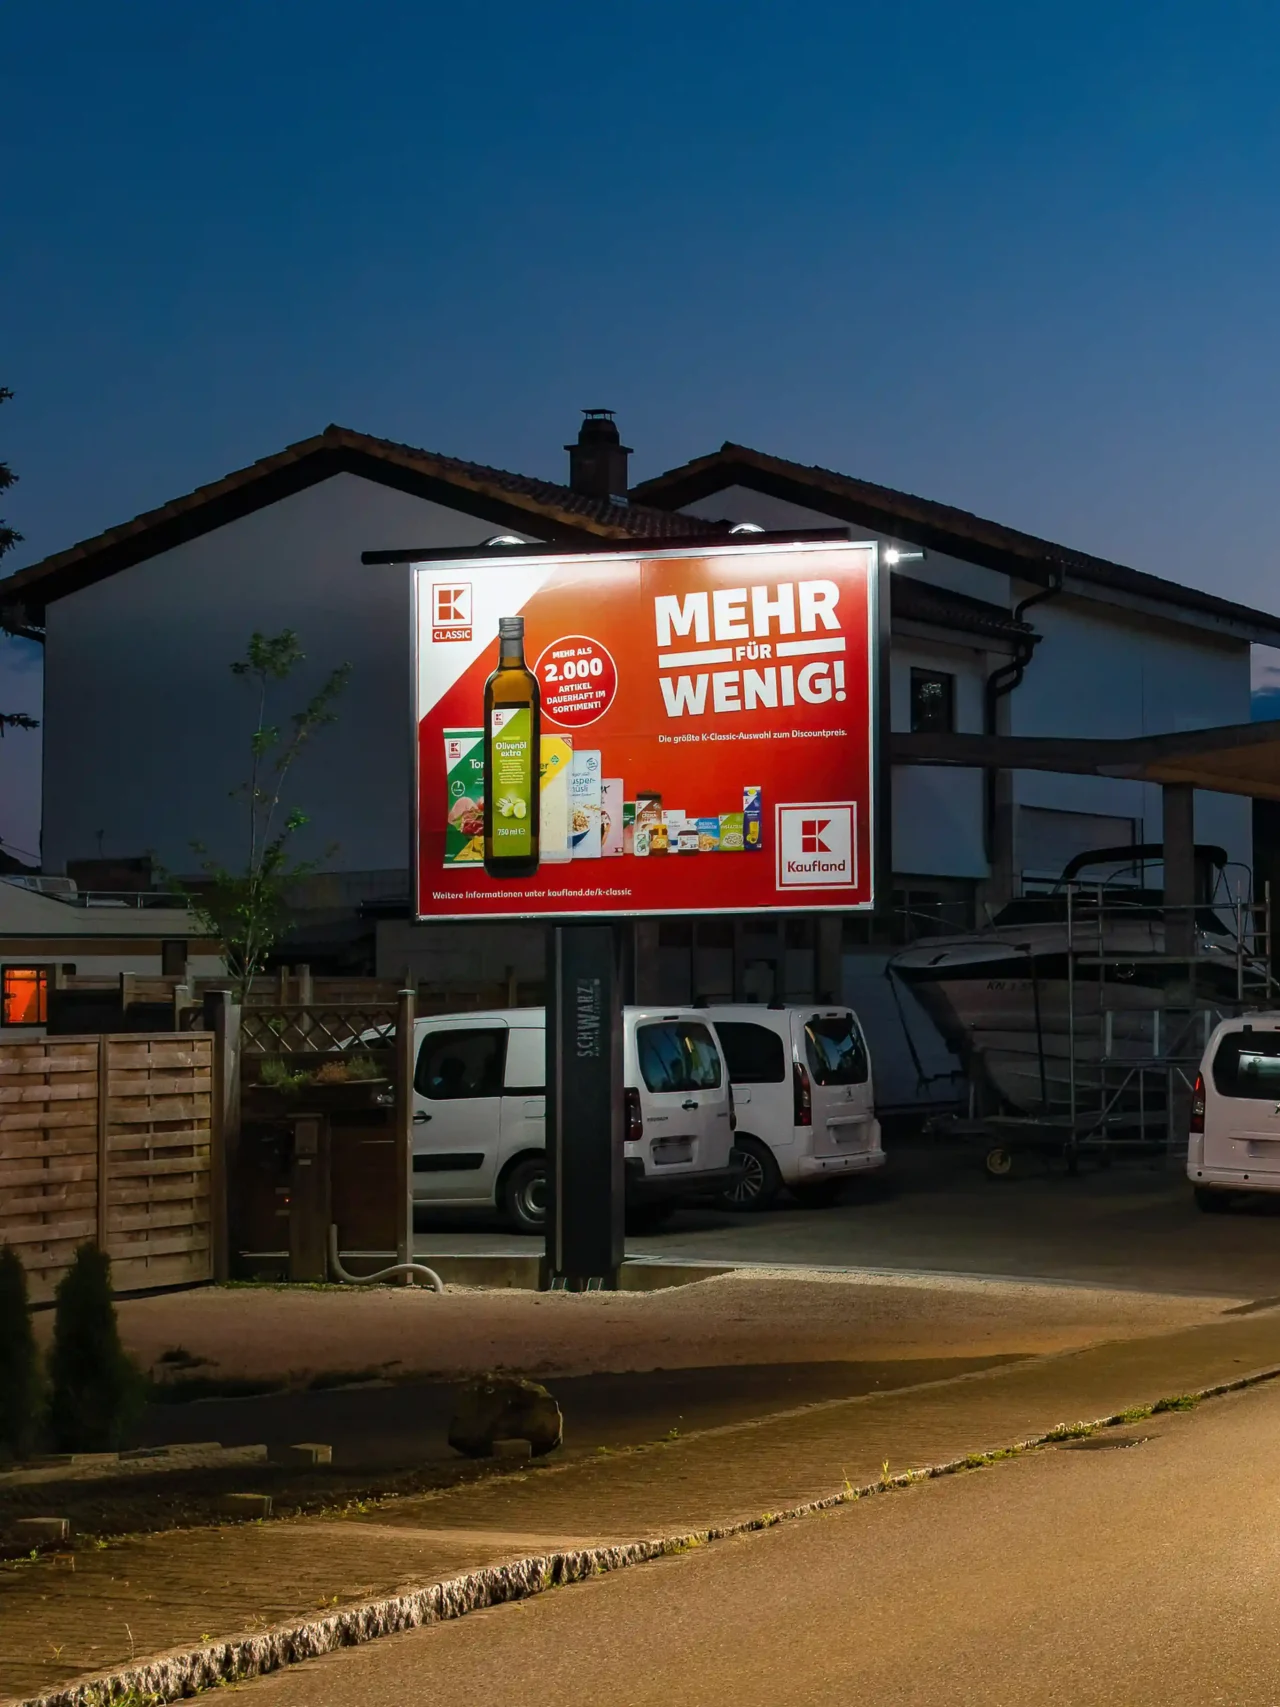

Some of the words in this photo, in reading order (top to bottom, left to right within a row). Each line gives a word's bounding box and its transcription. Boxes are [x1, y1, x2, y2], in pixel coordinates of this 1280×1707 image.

[654, 579, 841, 647] MEHR
[434, 630, 470, 640] CLASSIC
[552, 648, 576, 659] MEHR
[576, 646, 593, 656] ALS
[735, 641, 772, 662] FÜR
[544, 658, 603, 682] 2.000
[558, 682, 593, 693] ARTIKEL
[658, 660, 847, 718] WENIG!
[546, 692, 594, 705] DAUERHAFT
[595, 690, 606, 700] IM
[552, 702, 602, 714] SORTIMENT!
[658, 733, 672, 743] Die
[673, 732, 700, 744] größte
[701, 729, 772, 742] K-Classic-Auswahl
[773, 731, 790, 739] zum
[791, 728, 848, 740] Discountpreis.
[495, 741, 527, 750] Olivenöl
[500, 749, 522, 757] extra
[497, 828, 509, 836] 750
[787, 859, 846, 873] Kaufland
[432, 891, 464, 900] Weitere
[466, 890, 523, 899] Informationen
[524, 889, 546, 898] unter
[547, 887, 632, 898] kaufland.de/k-classic
[576, 985, 600, 1057] SCHWARZ
